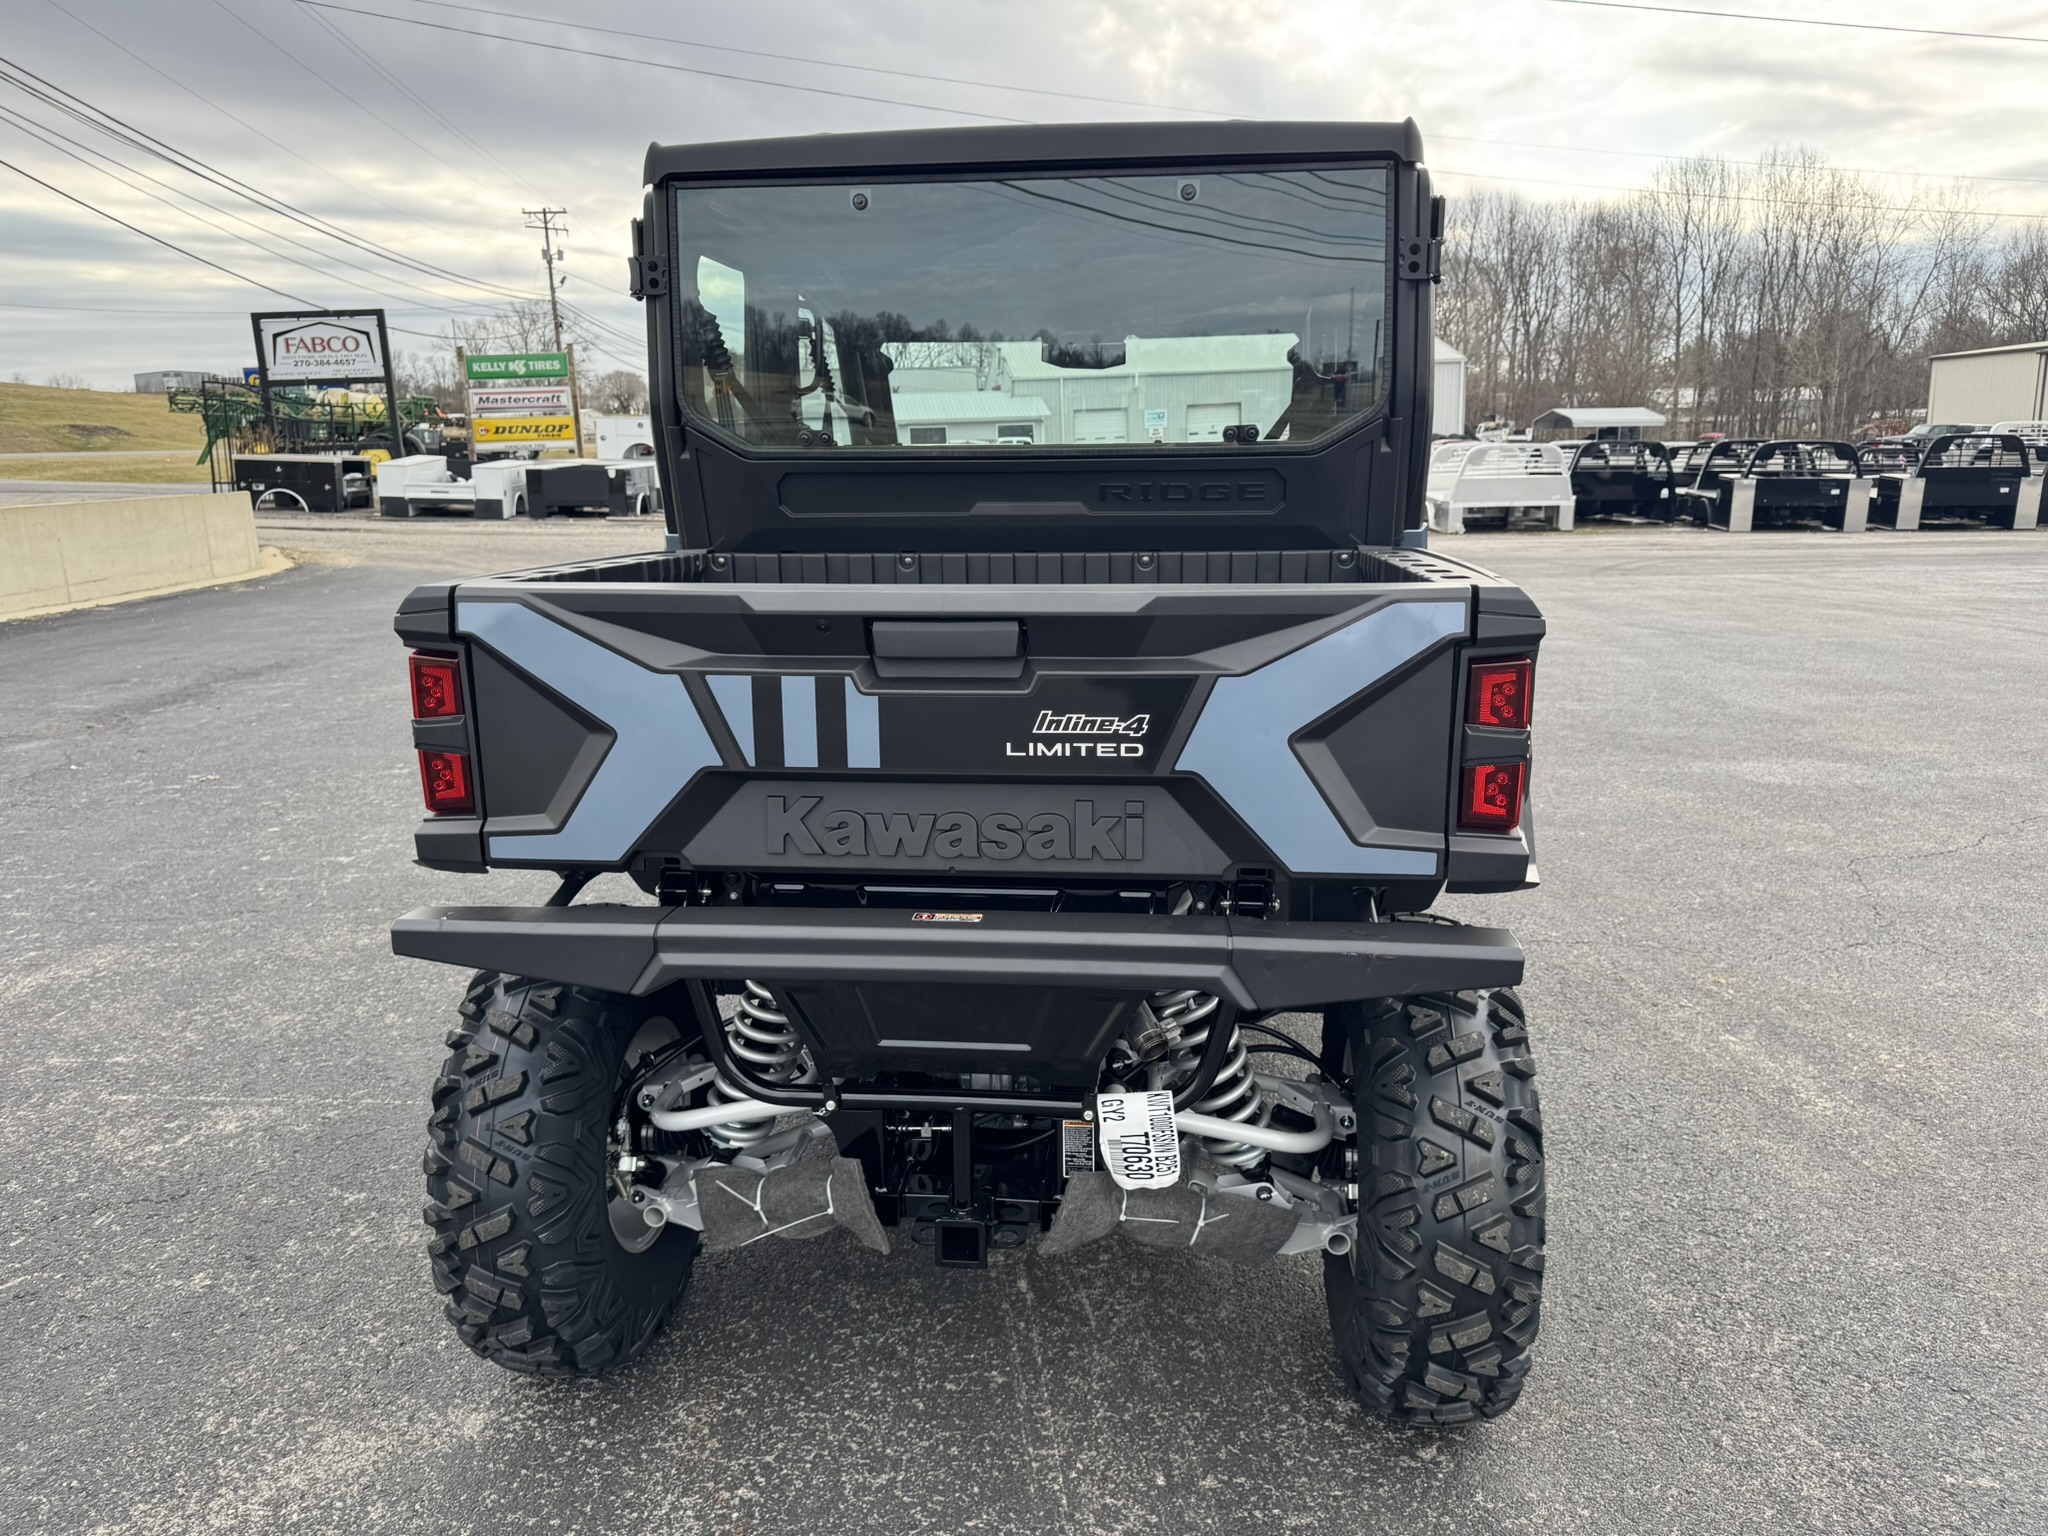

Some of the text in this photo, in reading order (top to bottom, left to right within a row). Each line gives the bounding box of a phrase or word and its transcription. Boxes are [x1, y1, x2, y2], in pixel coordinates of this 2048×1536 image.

[284, 335, 360, 354] FABCO
[293, 358, 357, 368] 270-384-4657
[471, 361, 507, 373] KELLY
[528, 359, 561, 371] TIRES
[478, 394, 561, 405] Mastercraft
[492, 423, 570, 436] DUNLOP
[1099, 481, 1267, 502] RIDGE
[1032, 710, 1150, 737] Inline-4
[1006, 742, 1144, 757] LIMITED
[766, 794, 1145, 861] Kawasaki
[1101, 1099, 1126, 1123] GY2
[1119, 1131, 1155, 1180] T70630
[1154, 1154, 1179, 1178] B251
